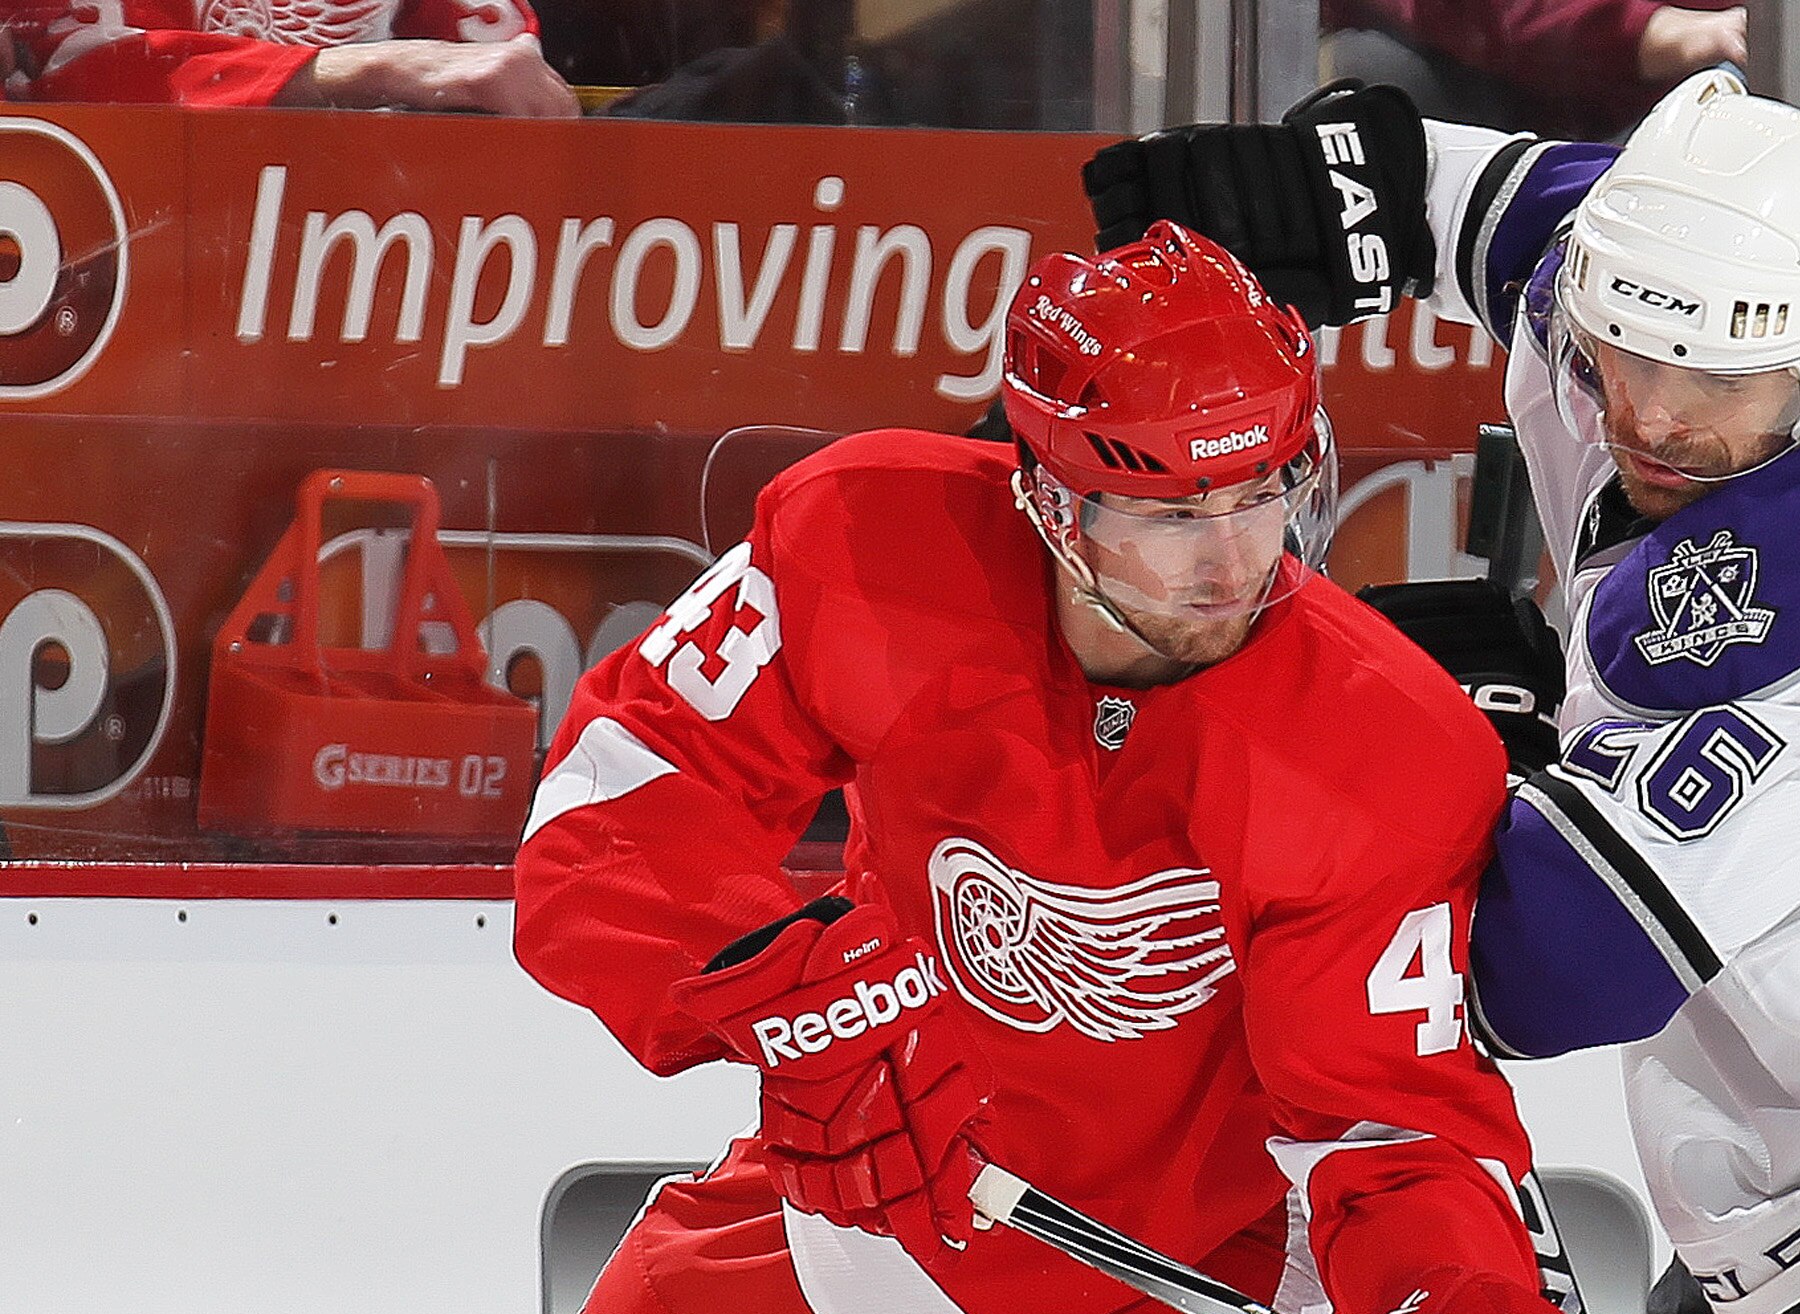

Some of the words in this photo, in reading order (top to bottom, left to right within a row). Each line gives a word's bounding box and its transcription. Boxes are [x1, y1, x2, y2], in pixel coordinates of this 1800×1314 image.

[235, 166, 1034, 399] Improving
[1611, 276, 1700, 315] CCM
[1035, 295, 1063, 321] Red
[1190, 424, 1269, 461] Reebok
[638, 541, 784, 721] 43
[459, 754, 507, 798] 02
[843, 938, 882, 965] Helm
[752, 951, 949, 1068] Reebok
